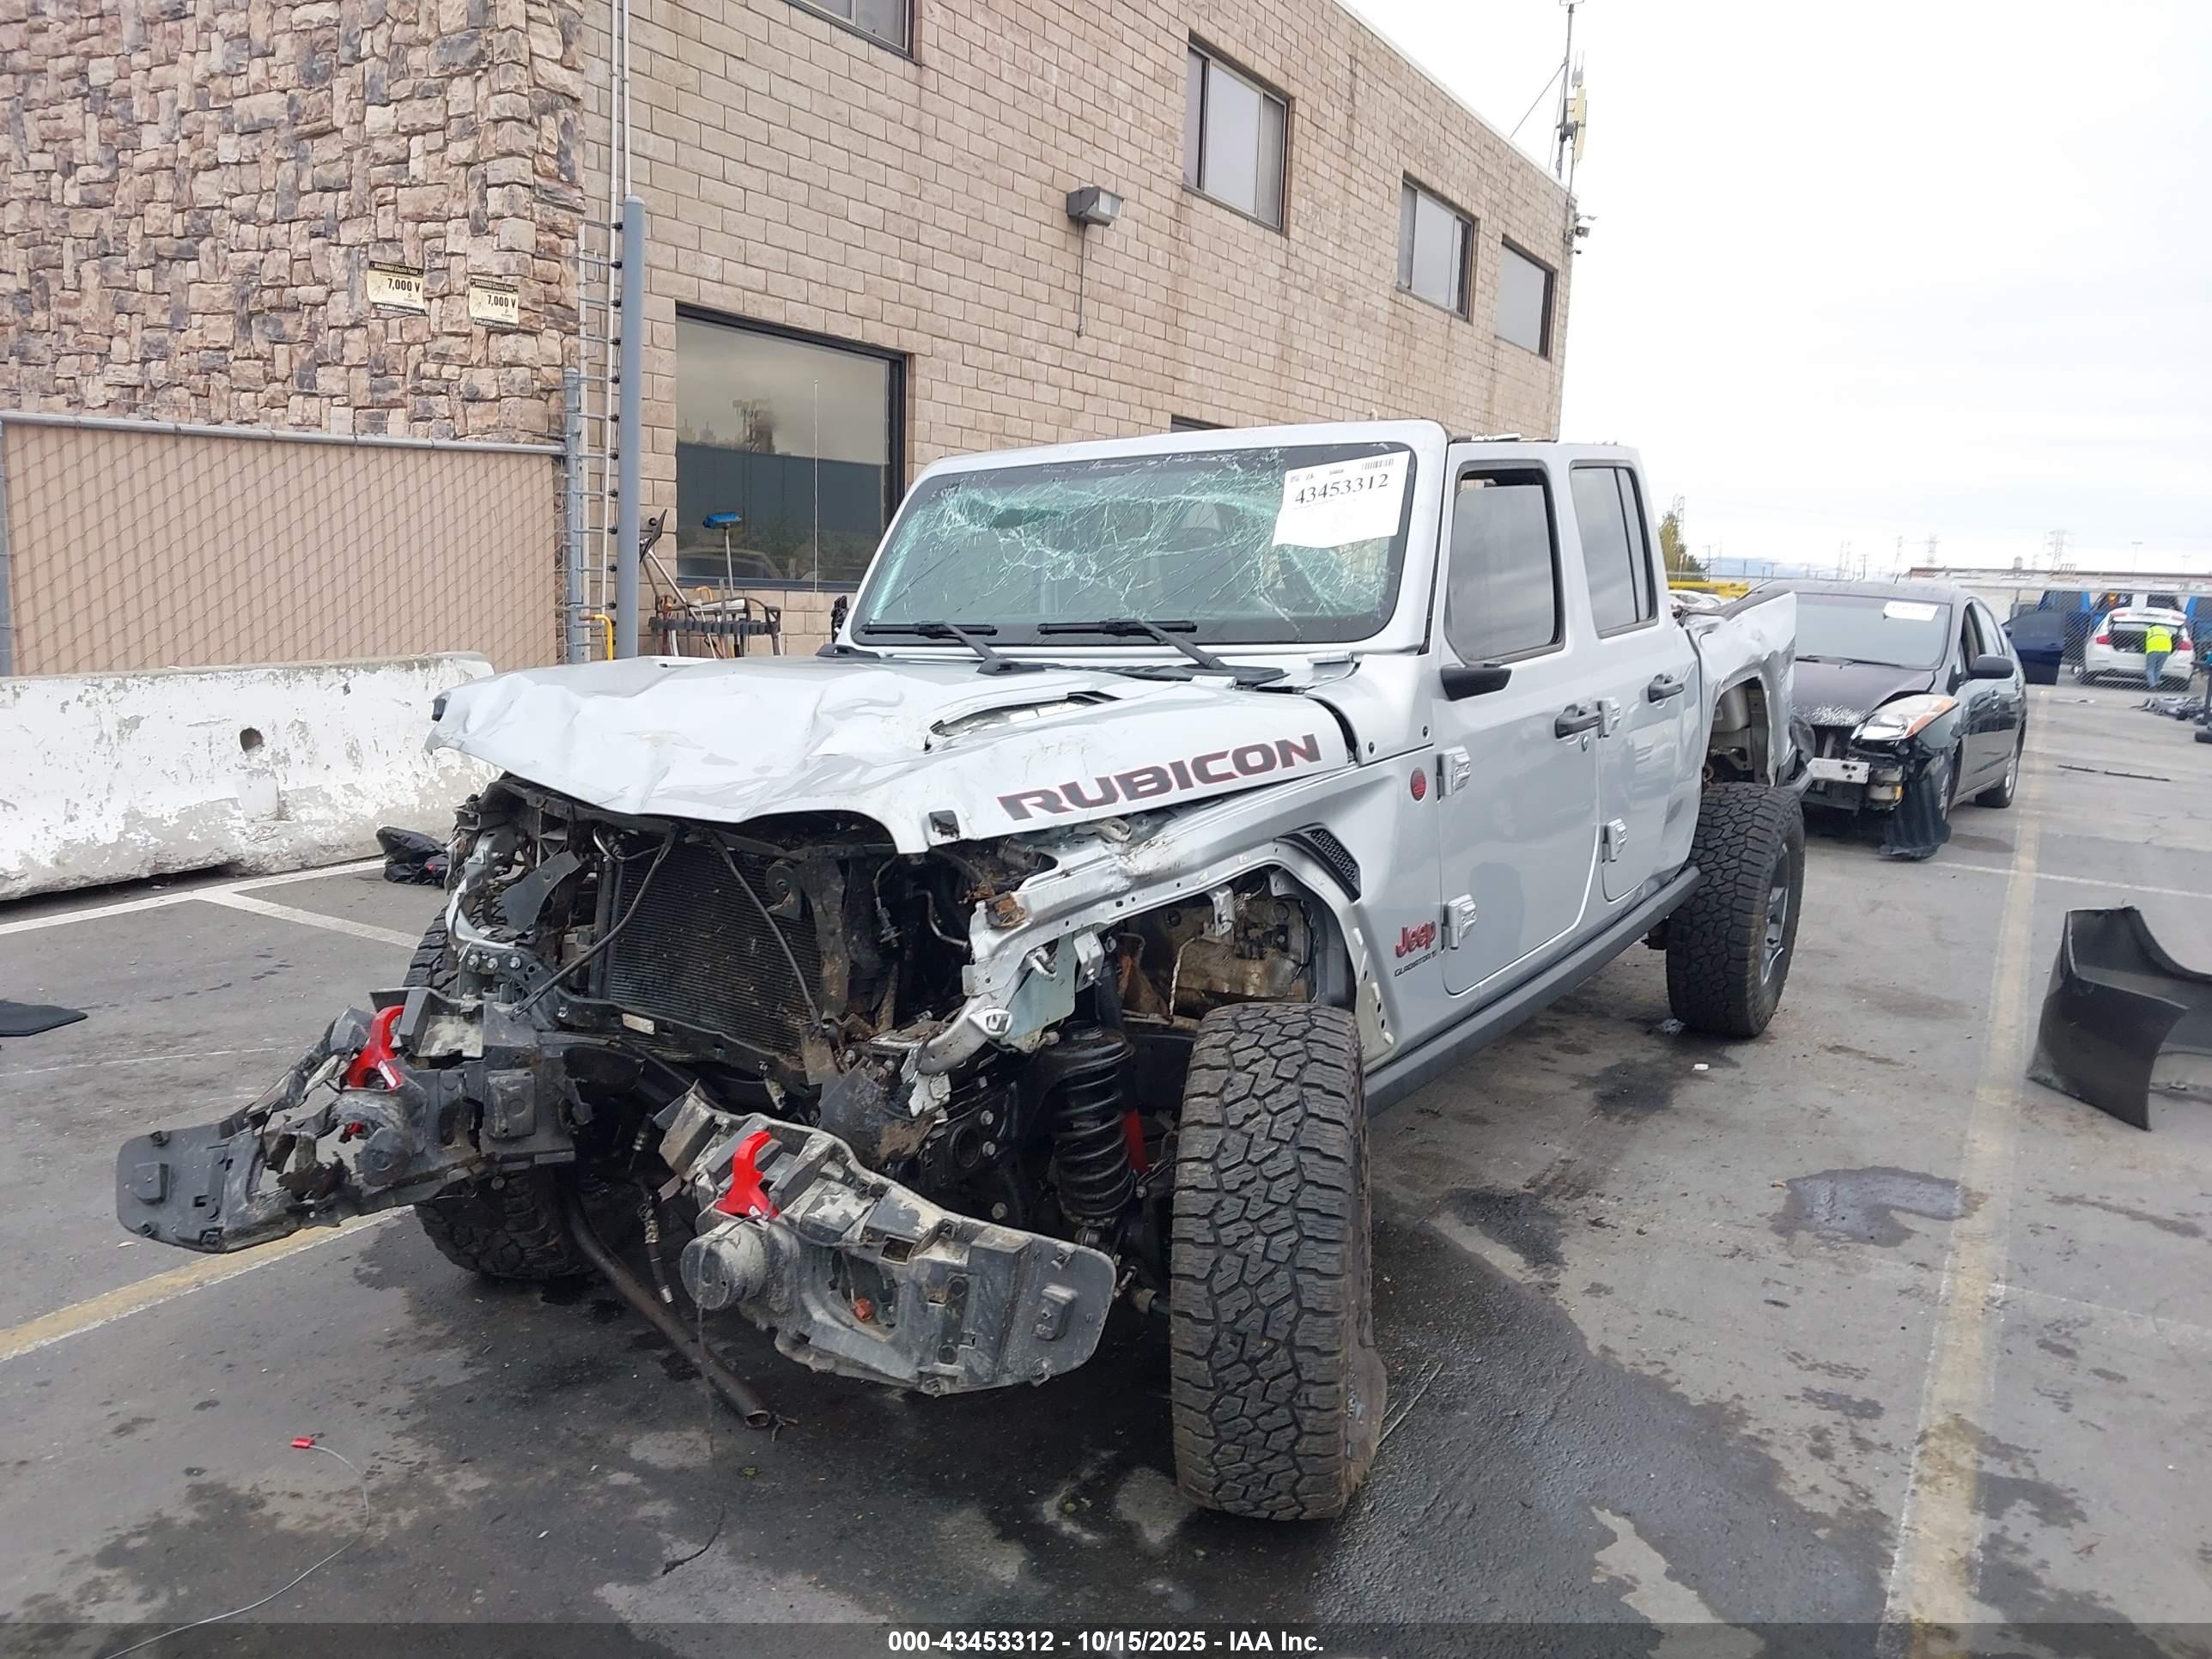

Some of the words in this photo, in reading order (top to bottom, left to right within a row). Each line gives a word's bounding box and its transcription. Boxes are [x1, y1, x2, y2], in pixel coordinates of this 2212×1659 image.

[387, 277, 412, 292] 7,000
[415, 282, 421, 293] V
[487, 295, 509, 307] 7,000
[511, 298, 516, 309] V
[1294, 473, 1389, 504] 43453312
[996, 732, 1322, 822] RUBICON
[1395, 920, 1437, 958] Jeep
